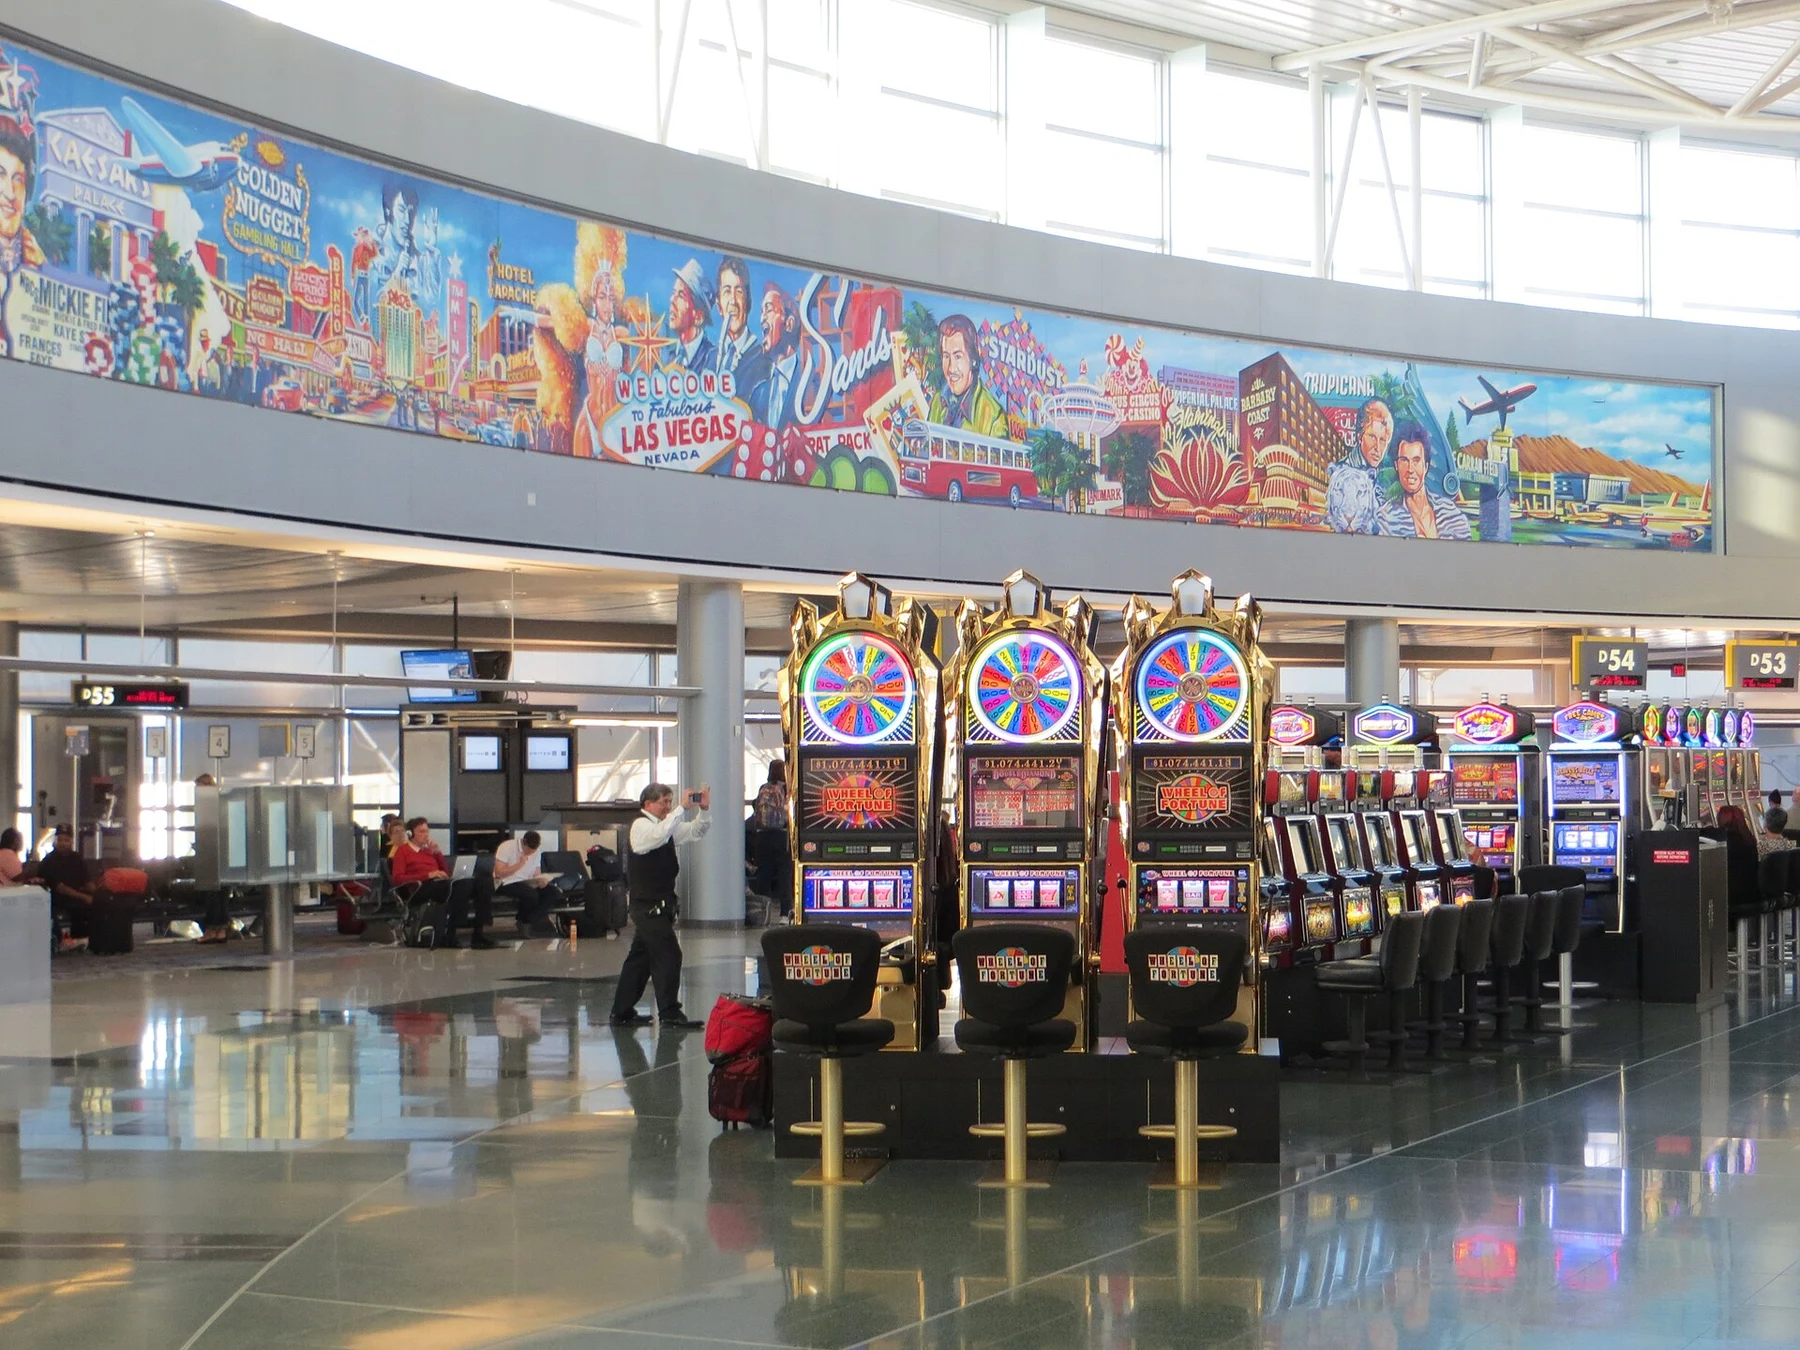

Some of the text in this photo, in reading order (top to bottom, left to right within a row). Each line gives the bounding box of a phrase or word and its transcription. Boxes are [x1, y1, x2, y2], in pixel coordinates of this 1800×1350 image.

[236, 159, 302, 211] GOLDEN
[235, 189, 302, 240] NUGGET
[232, 222, 301, 260] GAMBLING HALL
[293, 270, 329, 287] LUCKY
[497, 264, 534, 284] HOTEL
[292, 281, 328, 298] STRIKE
[332, 257, 342, 334] BINGO
[494, 285, 536, 304] APACHE
[40, 278, 90, 319] MICKIE
[95, 296, 111, 325] FI
[54, 324, 77, 341] KAYE
[451, 300, 461, 374] MINT
[19, 333, 62, 357] FRANCES
[795, 273, 891, 424] Sands
[988, 336, 1065, 389] STARDUST
[618, 374, 731, 398] WELCOME
[1304, 371, 1375, 397] TROPICANA
[1129, 393, 1160, 408] CIRCUS
[1210, 393, 1239, 410] PALACE
[1241, 386, 1277, 412] BARBARY
[632, 400, 716, 422] TO Fabulous
[1128, 407, 1160, 421] CASINO
[1247, 409, 1271, 427] COAST
[621, 413, 738, 454] LAS VEGAS
[838, 432, 872, 450] PACK
[645, 450, 700, 466] NEVADA
[1598, 649, 1635, 671] D54
[1750, 652, 1786, 675] D53
[82, 686, 115, 705] D55
[216, 737, 222, 748] 4
[1021, 770, 1056, 780] DIAMOND
[827, 787, 892, 799] WHEEL OF
[1160, 786, 1227, 798] WHEEL OF
[827, 800, 892, 811] FORTUNE
[1160, 798, 1227, 810] FORTUNE
[824, 888, 840, 902] 7
[849, 888, 866, 902] 7
[874, 888, 891, 902] 7
[1040, 889, 1058, 902] 7
[1210, 889, 1227, 902] 7
[784, 953, 852, 966] WHEEL OF
[977, 955, 1046, 968] WHEEL OF
[1148, 954, 1218, 968] WHEEL OF
[786, 967, 851, 980] FORTUNE
[979, 968, 1046, 982] FORTUNE
[1150, 968, 1217, 981] FORTUNE
